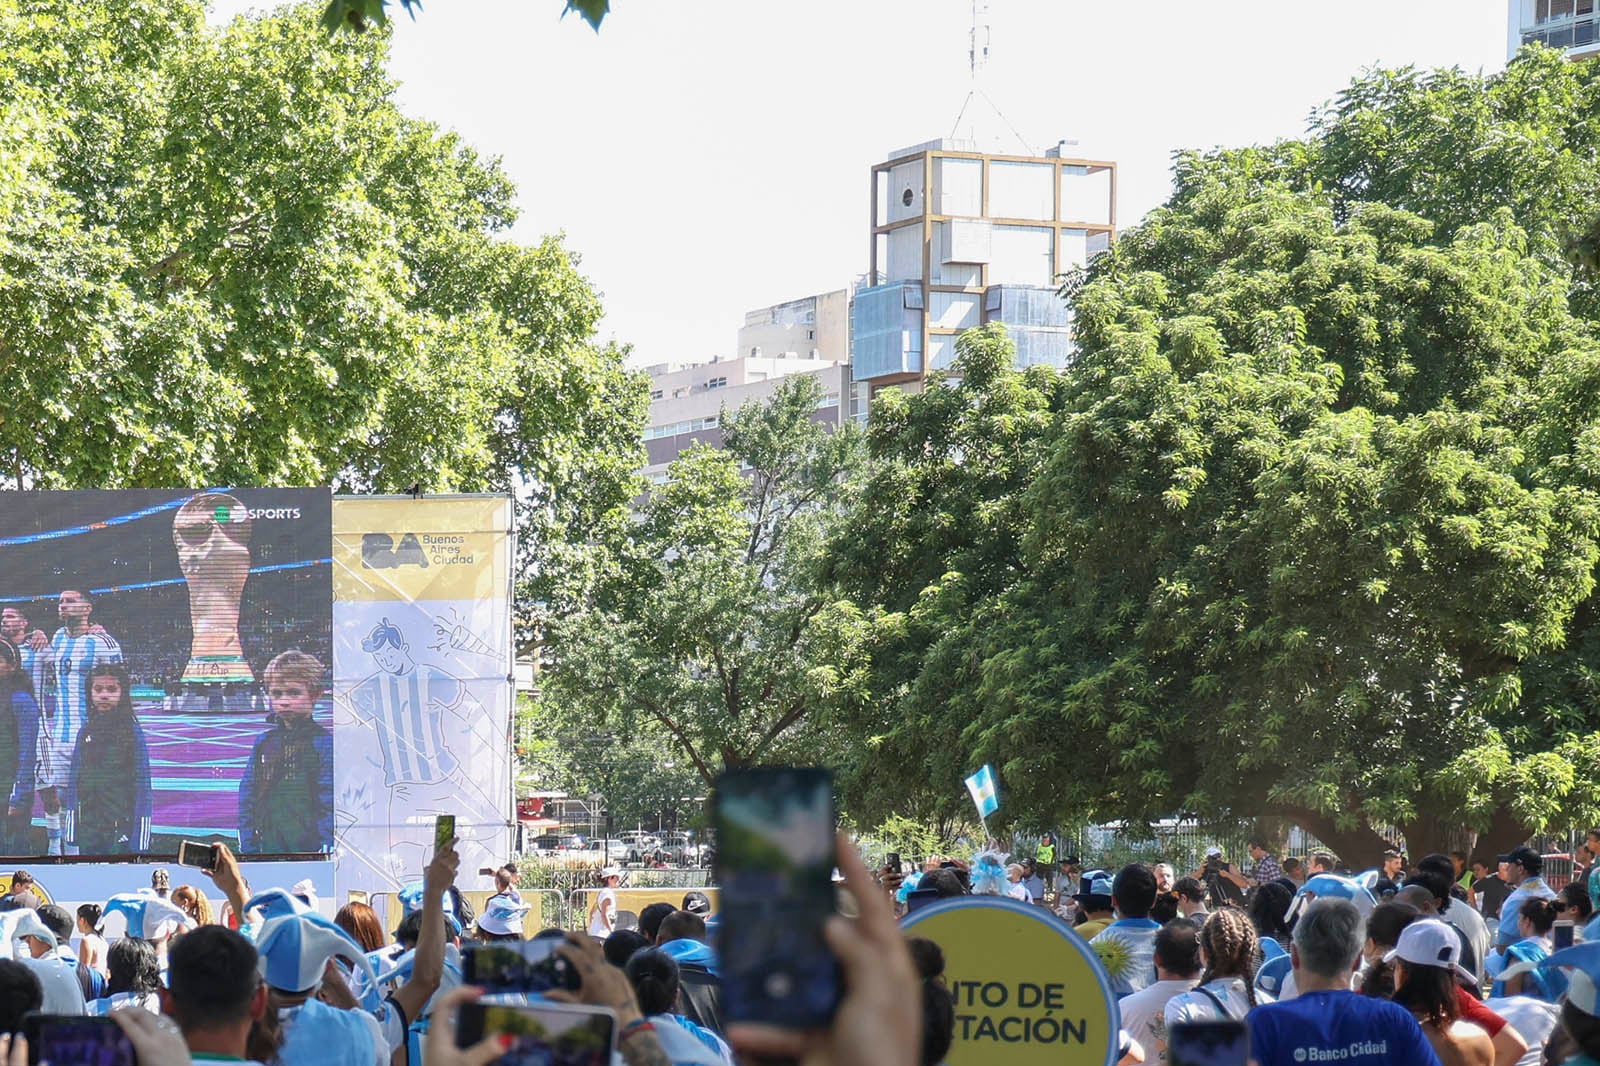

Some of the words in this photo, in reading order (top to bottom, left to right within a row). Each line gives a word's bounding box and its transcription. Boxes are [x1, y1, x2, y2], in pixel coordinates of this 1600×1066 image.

[249, 508, 300, 520] SPORTS
[423, 535, 464, 544] Buenos
[362, 533, 429, 569] BA
[430, 545, 460, 554] Aires
[433, 555, 473, 564] Ciudad
[1018, 983, 1064, 1009] DE
[952, 1010, 1087, 1044] TACIÓN
[1308, 1047, 1348, 1061] Banco
